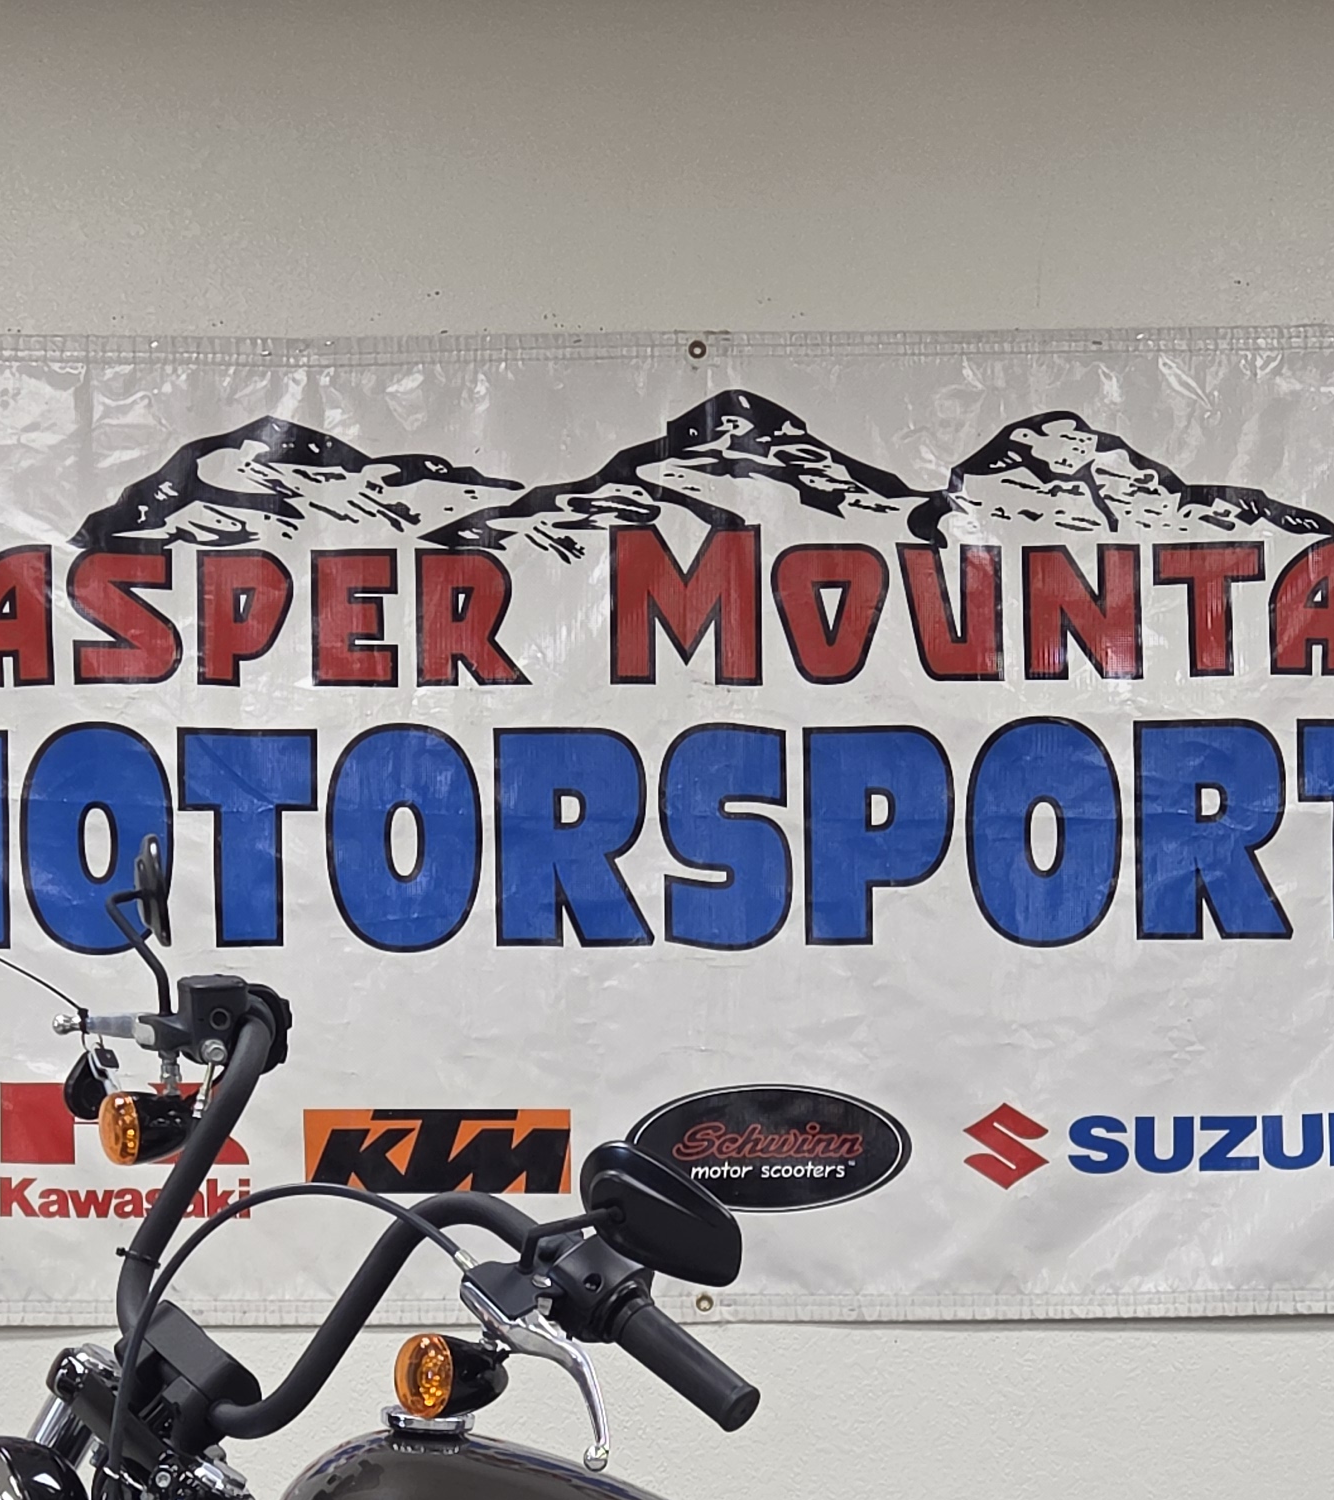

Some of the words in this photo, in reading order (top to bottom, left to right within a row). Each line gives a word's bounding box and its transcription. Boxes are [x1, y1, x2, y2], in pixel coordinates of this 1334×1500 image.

[311, 1109, 571, 1194] KTM
[671, 1122, 863, 1160] Schwinn
[690, 1161, 753, 1179] motor
[760, 1161, 846, 1179] scooters
